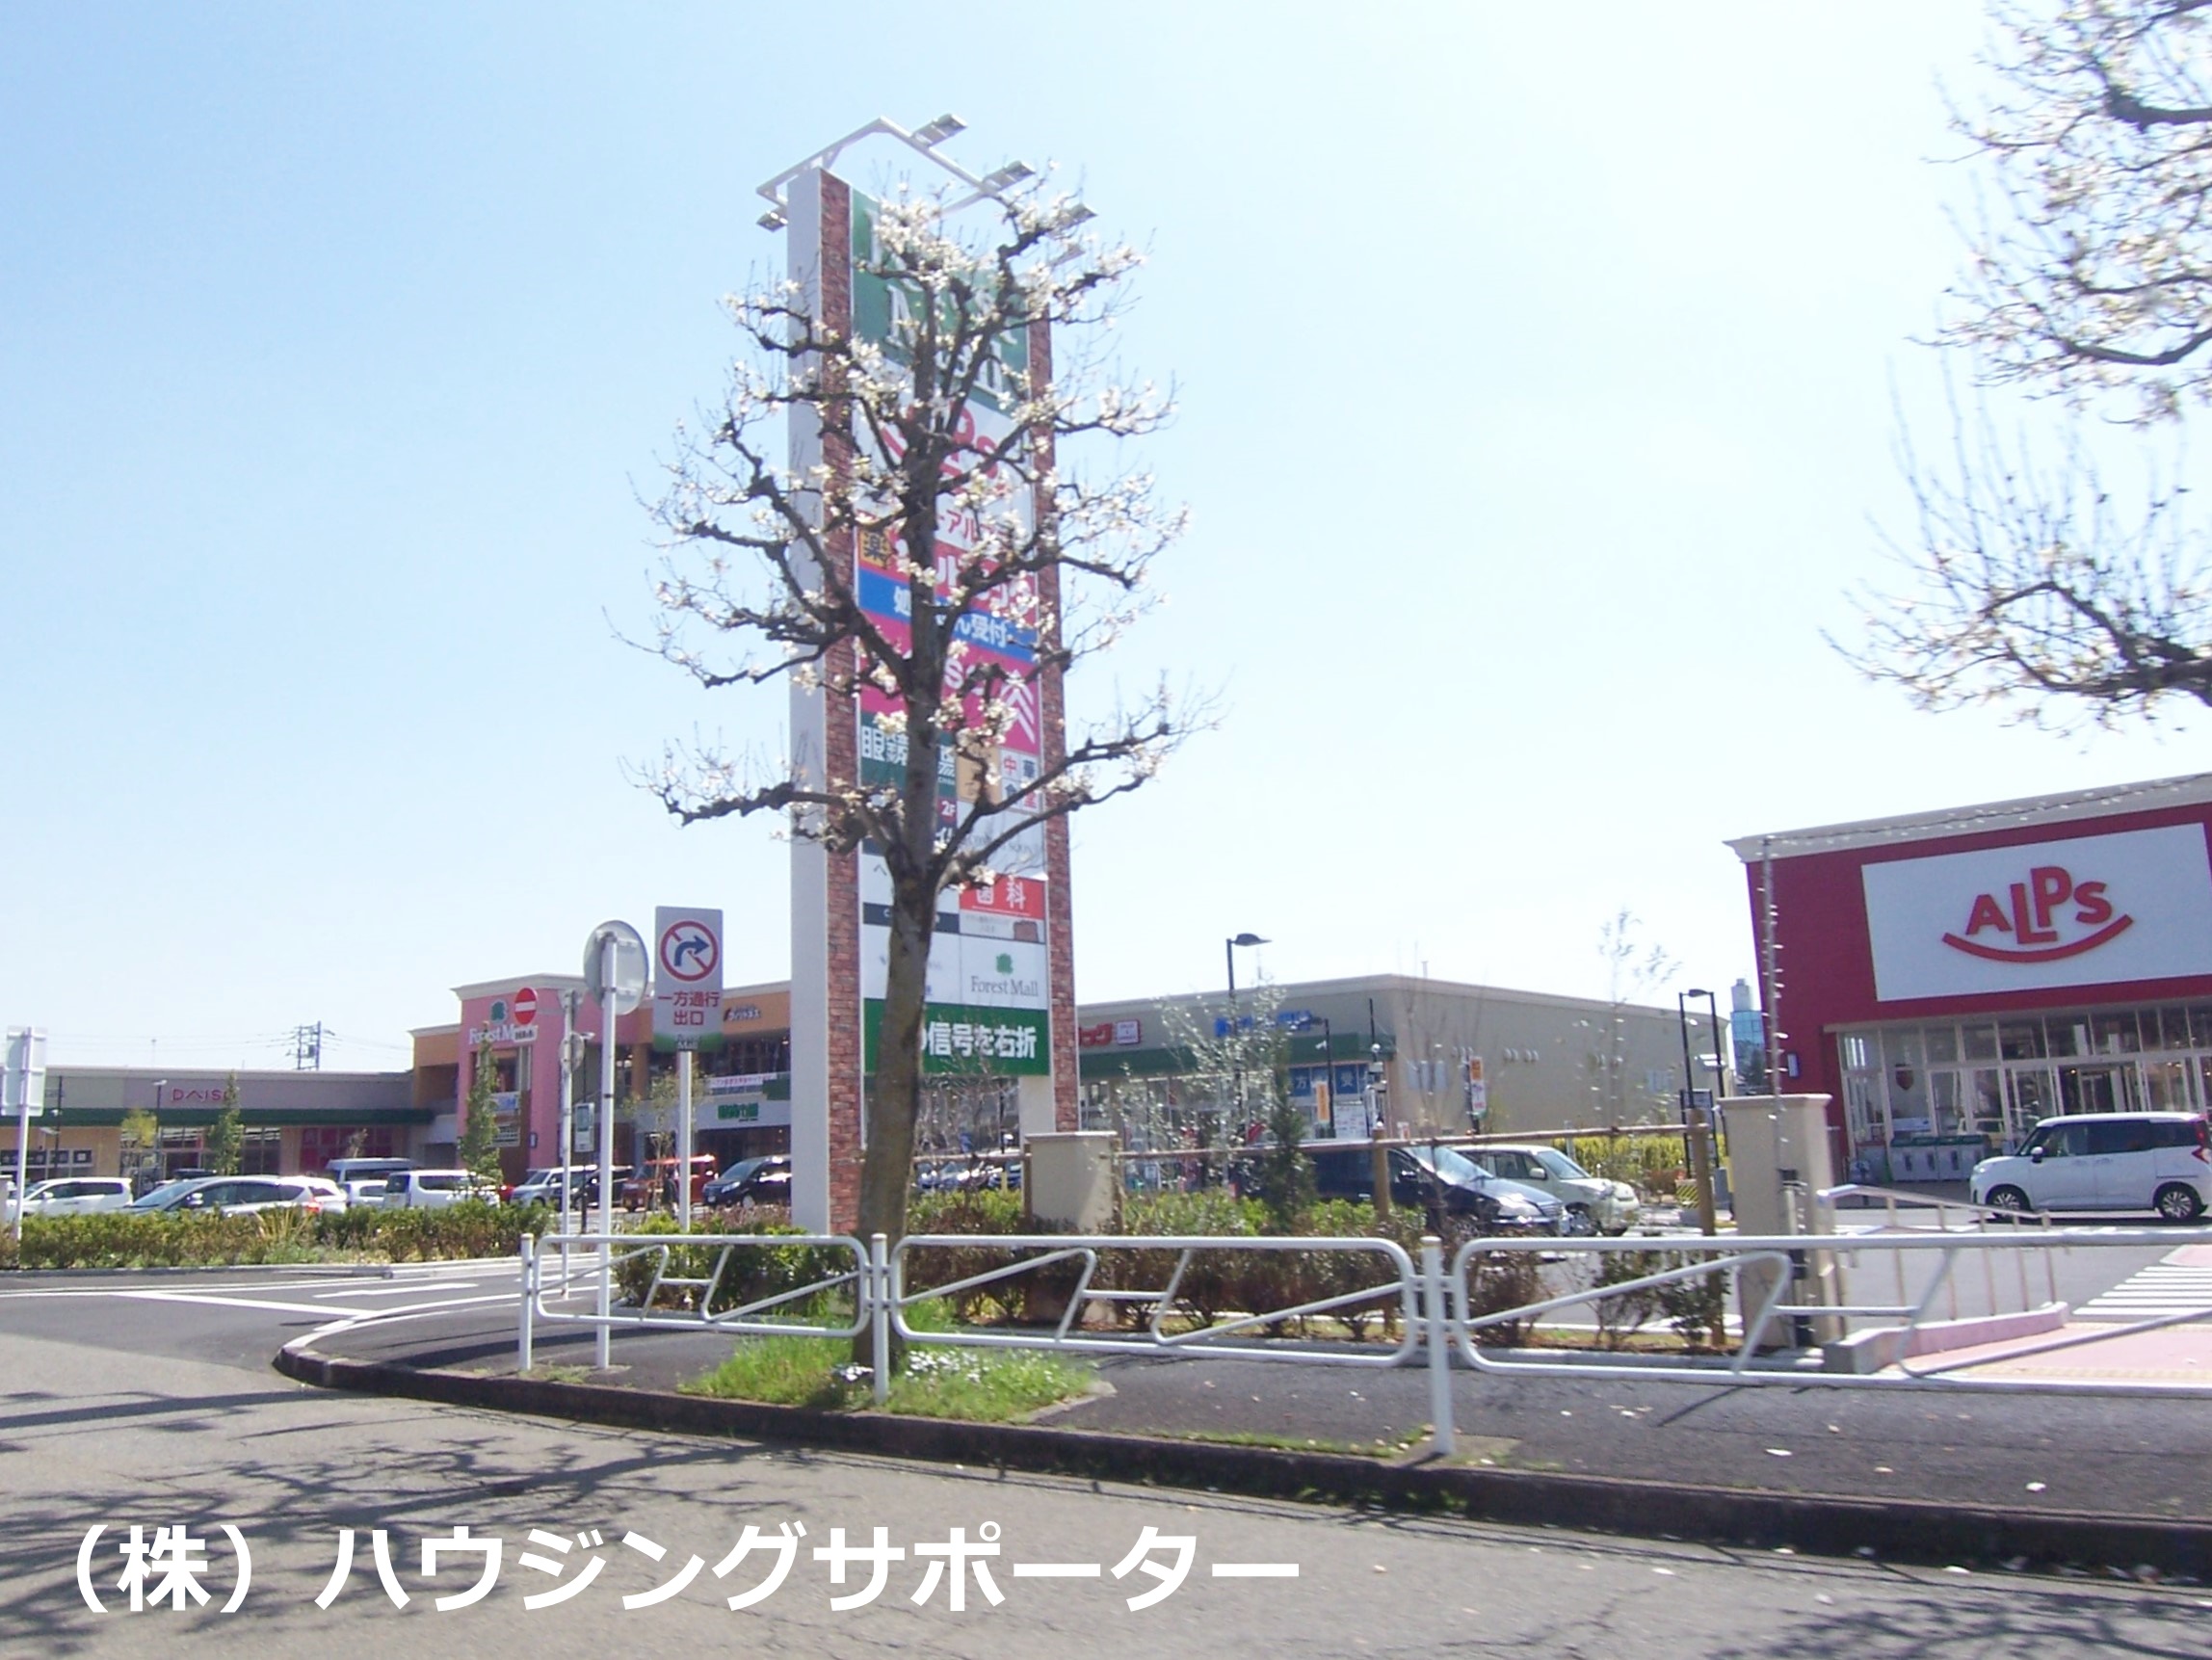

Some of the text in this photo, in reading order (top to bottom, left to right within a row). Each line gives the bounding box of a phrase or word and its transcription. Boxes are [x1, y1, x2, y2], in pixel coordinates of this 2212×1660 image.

[1965, 866, 2113, 945] ALPS
[970, 975, 1040, 997] Forest Mall
[657, 989, 721, 1008] 一方通行
[674, 1009, 704, 1026] 出口
